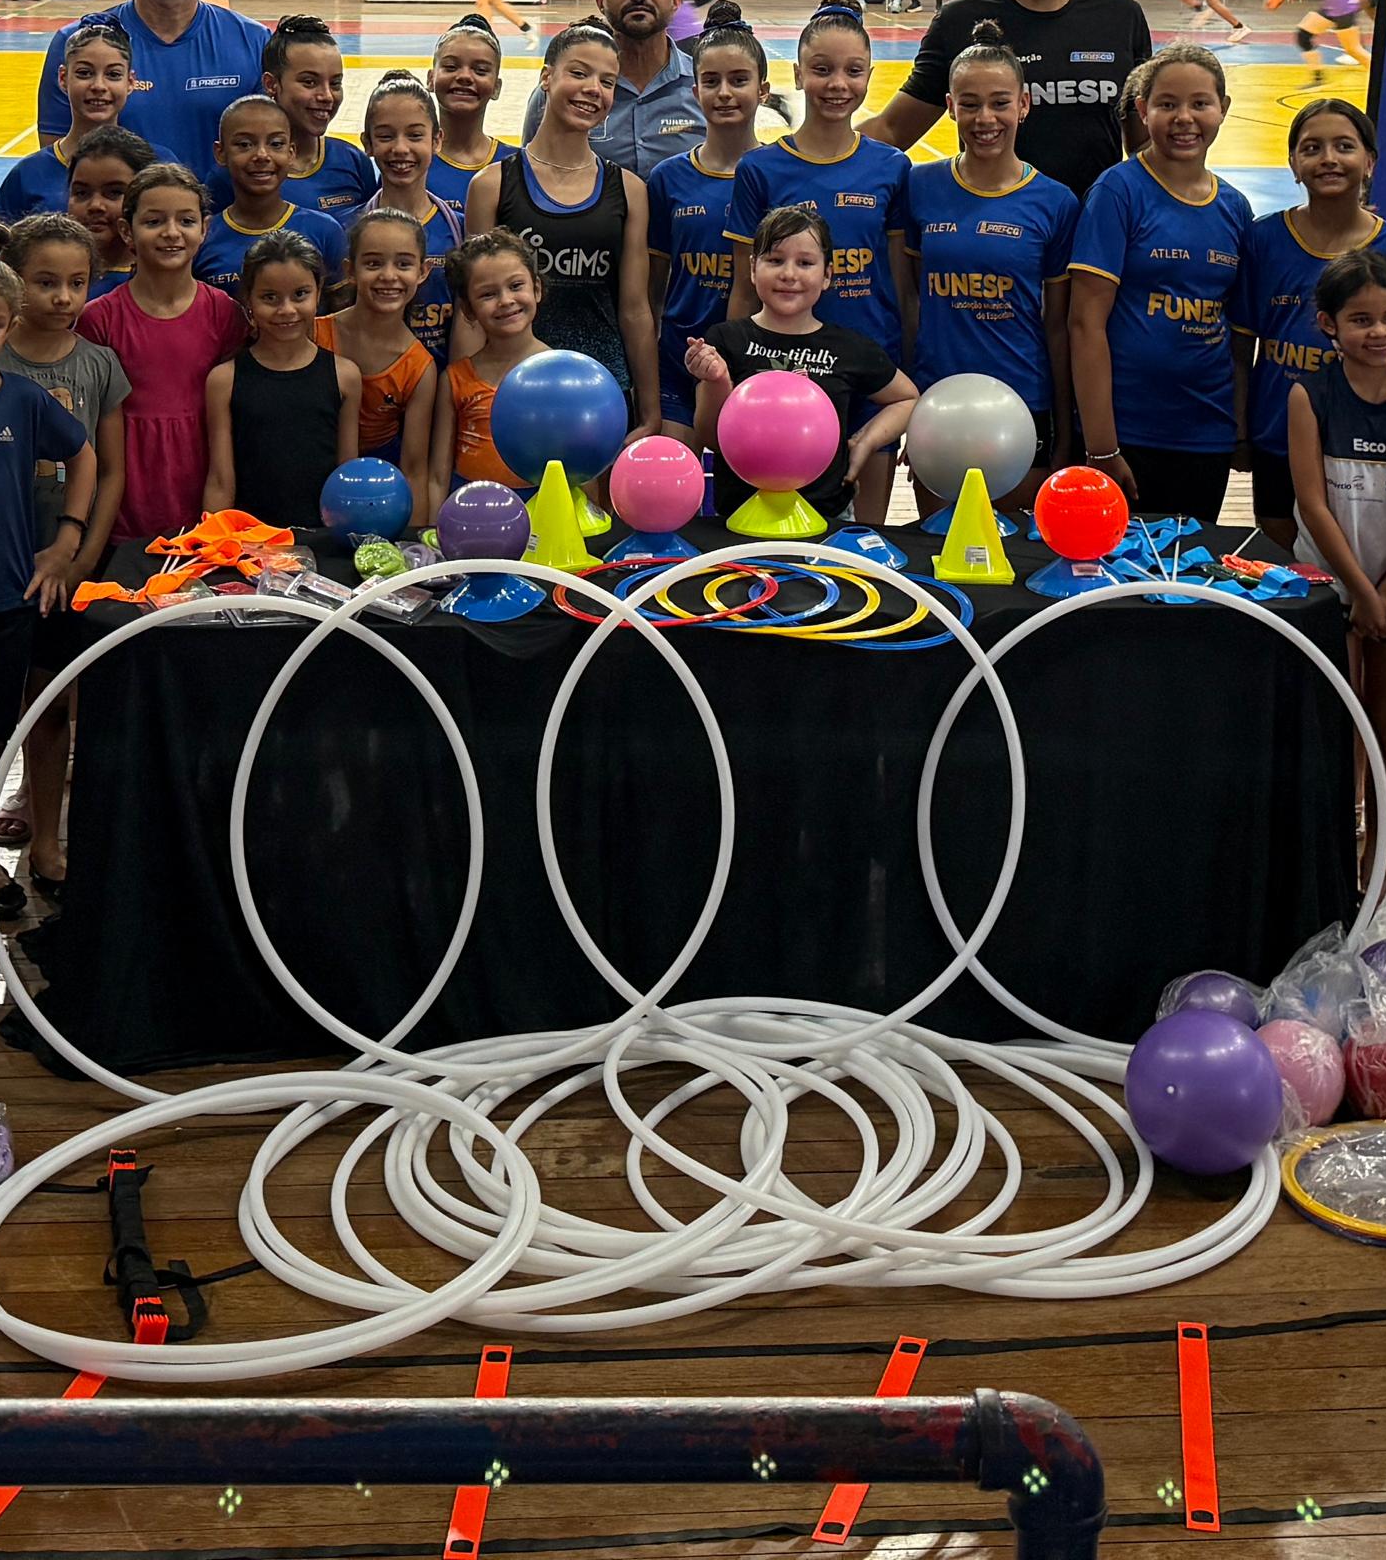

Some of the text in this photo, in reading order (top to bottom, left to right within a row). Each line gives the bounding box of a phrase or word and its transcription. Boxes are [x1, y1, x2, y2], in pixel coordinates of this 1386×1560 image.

[132, 80, 153, 91] ESP
[1024, 79, 1118, 106] NESP
[832, 248, 873, 274] ESP
[1150, 248, 1190, 260] ATLETA
[927, 272, 1014, 299] FUNESP
